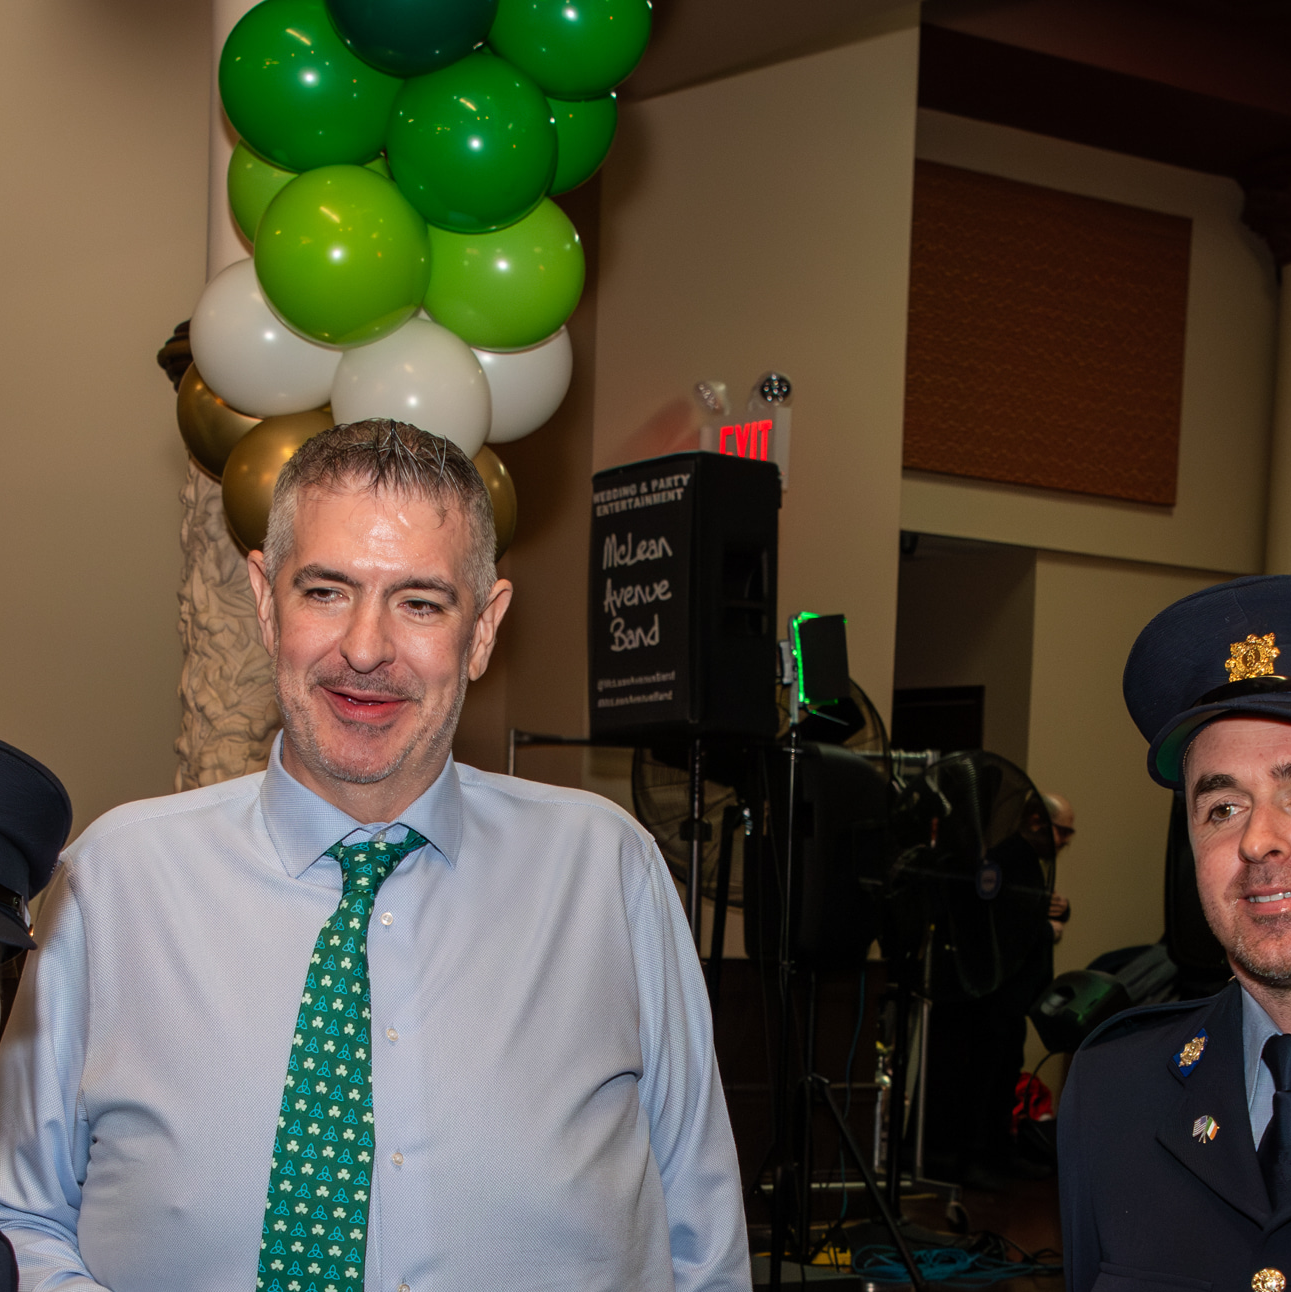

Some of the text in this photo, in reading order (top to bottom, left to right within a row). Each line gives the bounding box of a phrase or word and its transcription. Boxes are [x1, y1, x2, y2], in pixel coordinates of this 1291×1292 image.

[718, 420, 773, 462] EXIT
[592, 473, 691, 504] WEDDING & PARTY
[596, 488, 685, 517] ENTERTAINMENT
[601, 532, 673, 570] McLean
[602, 577, 673, 617] Avenue
[609, 613, 660, 653] Band
